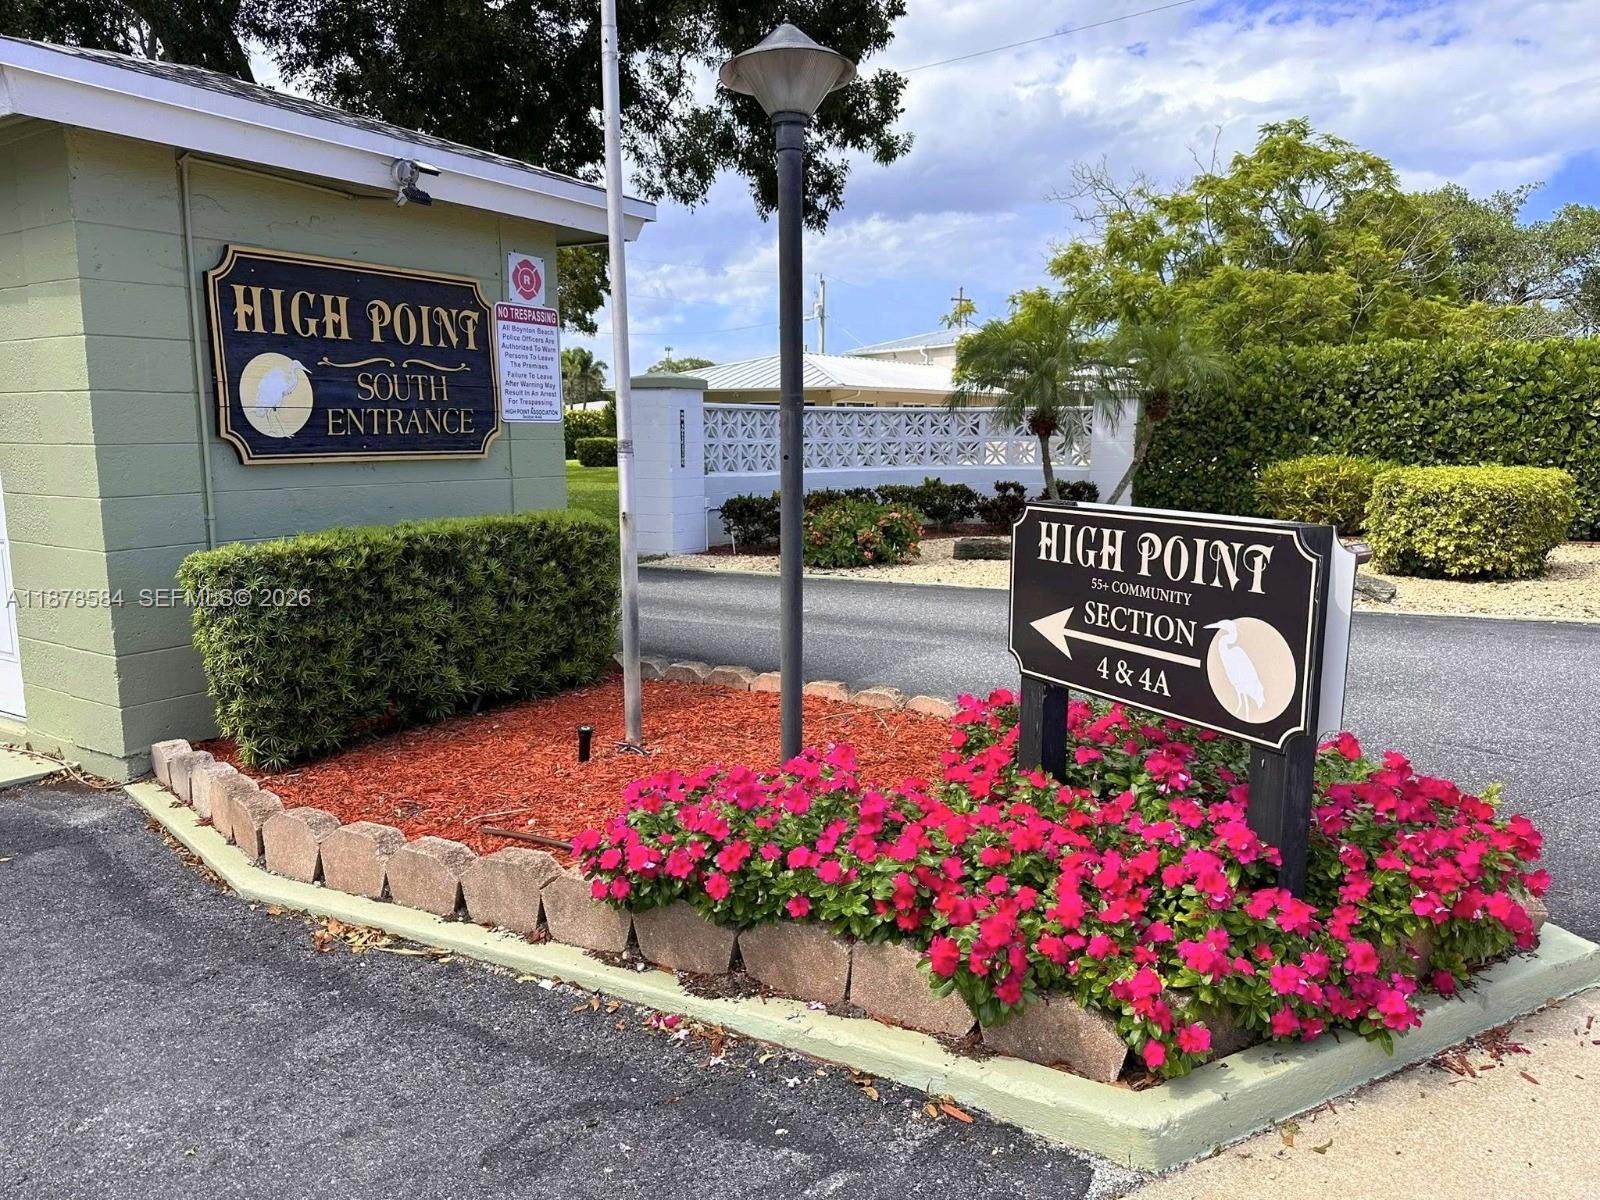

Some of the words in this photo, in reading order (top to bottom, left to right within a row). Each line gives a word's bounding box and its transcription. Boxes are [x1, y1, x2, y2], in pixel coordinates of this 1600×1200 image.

[230, 283, 352, 341] HIGH
[365, 299, 480, 351] POINT
[498, 306, 508, 318] NO
[510, 307, 556, 324] TRESPASSING
[502, 333, 520, 341] Police
[522, 335, 544, 344] Officers
[502, 342, 532, 351] Authorized
[504, 352, 528, 360] Persons
[356, 372, 448, 401] SOUTH
[327, 408, 475, 436] ENTRANCE
[1038, 520, 1126, 574] HIGH
[1136, 532, 1274, 595] POINT
[1091, 577, 1110, 592] 55+
[1112, 580, 1192, 606] COMMUNITY
[1084, 600, 1198, 648] SECTION
[1096, 656, 1110, 680] 4
[1115, 659, 1134, 687] &
[1138, 665, 1172, 698] 4A
